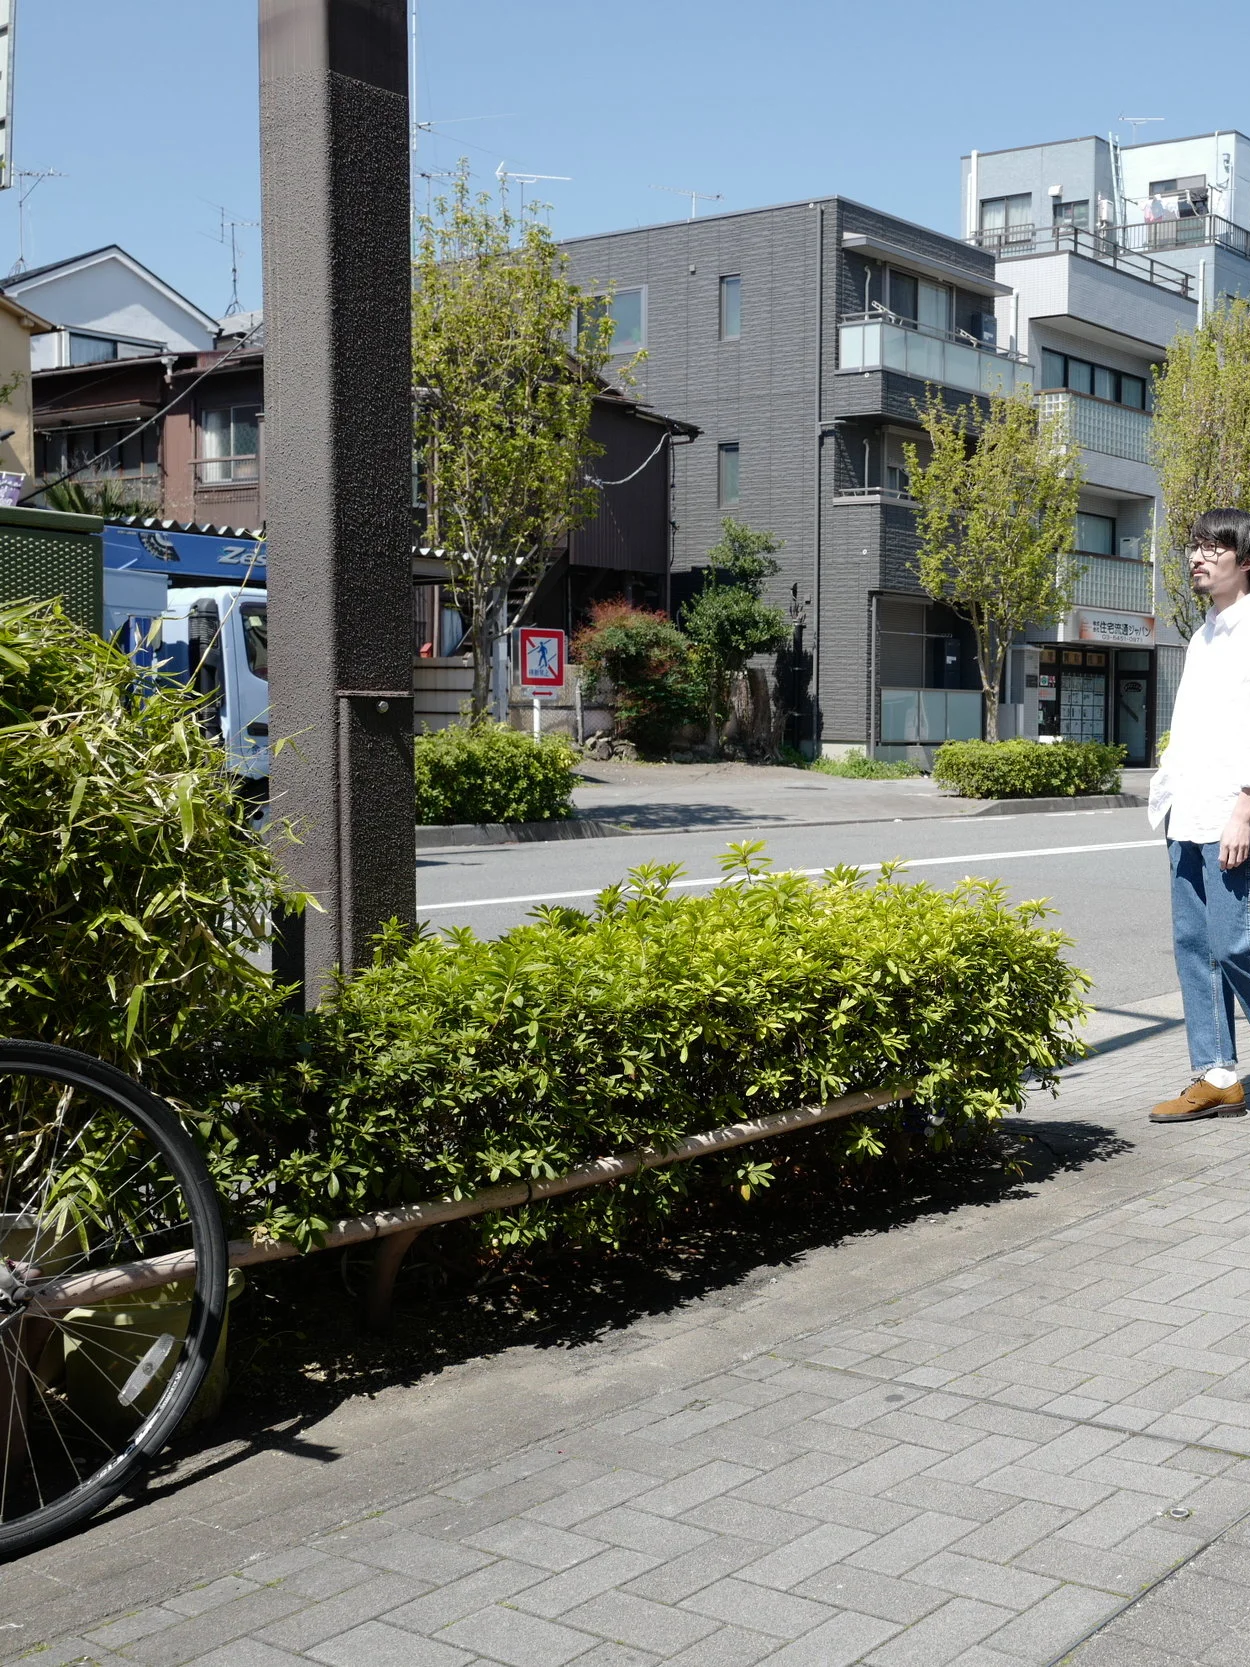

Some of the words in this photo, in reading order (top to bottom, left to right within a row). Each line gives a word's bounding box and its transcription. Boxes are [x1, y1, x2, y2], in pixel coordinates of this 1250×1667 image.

[1099, 620, 1151, 637] 住宅流通ジャパン
